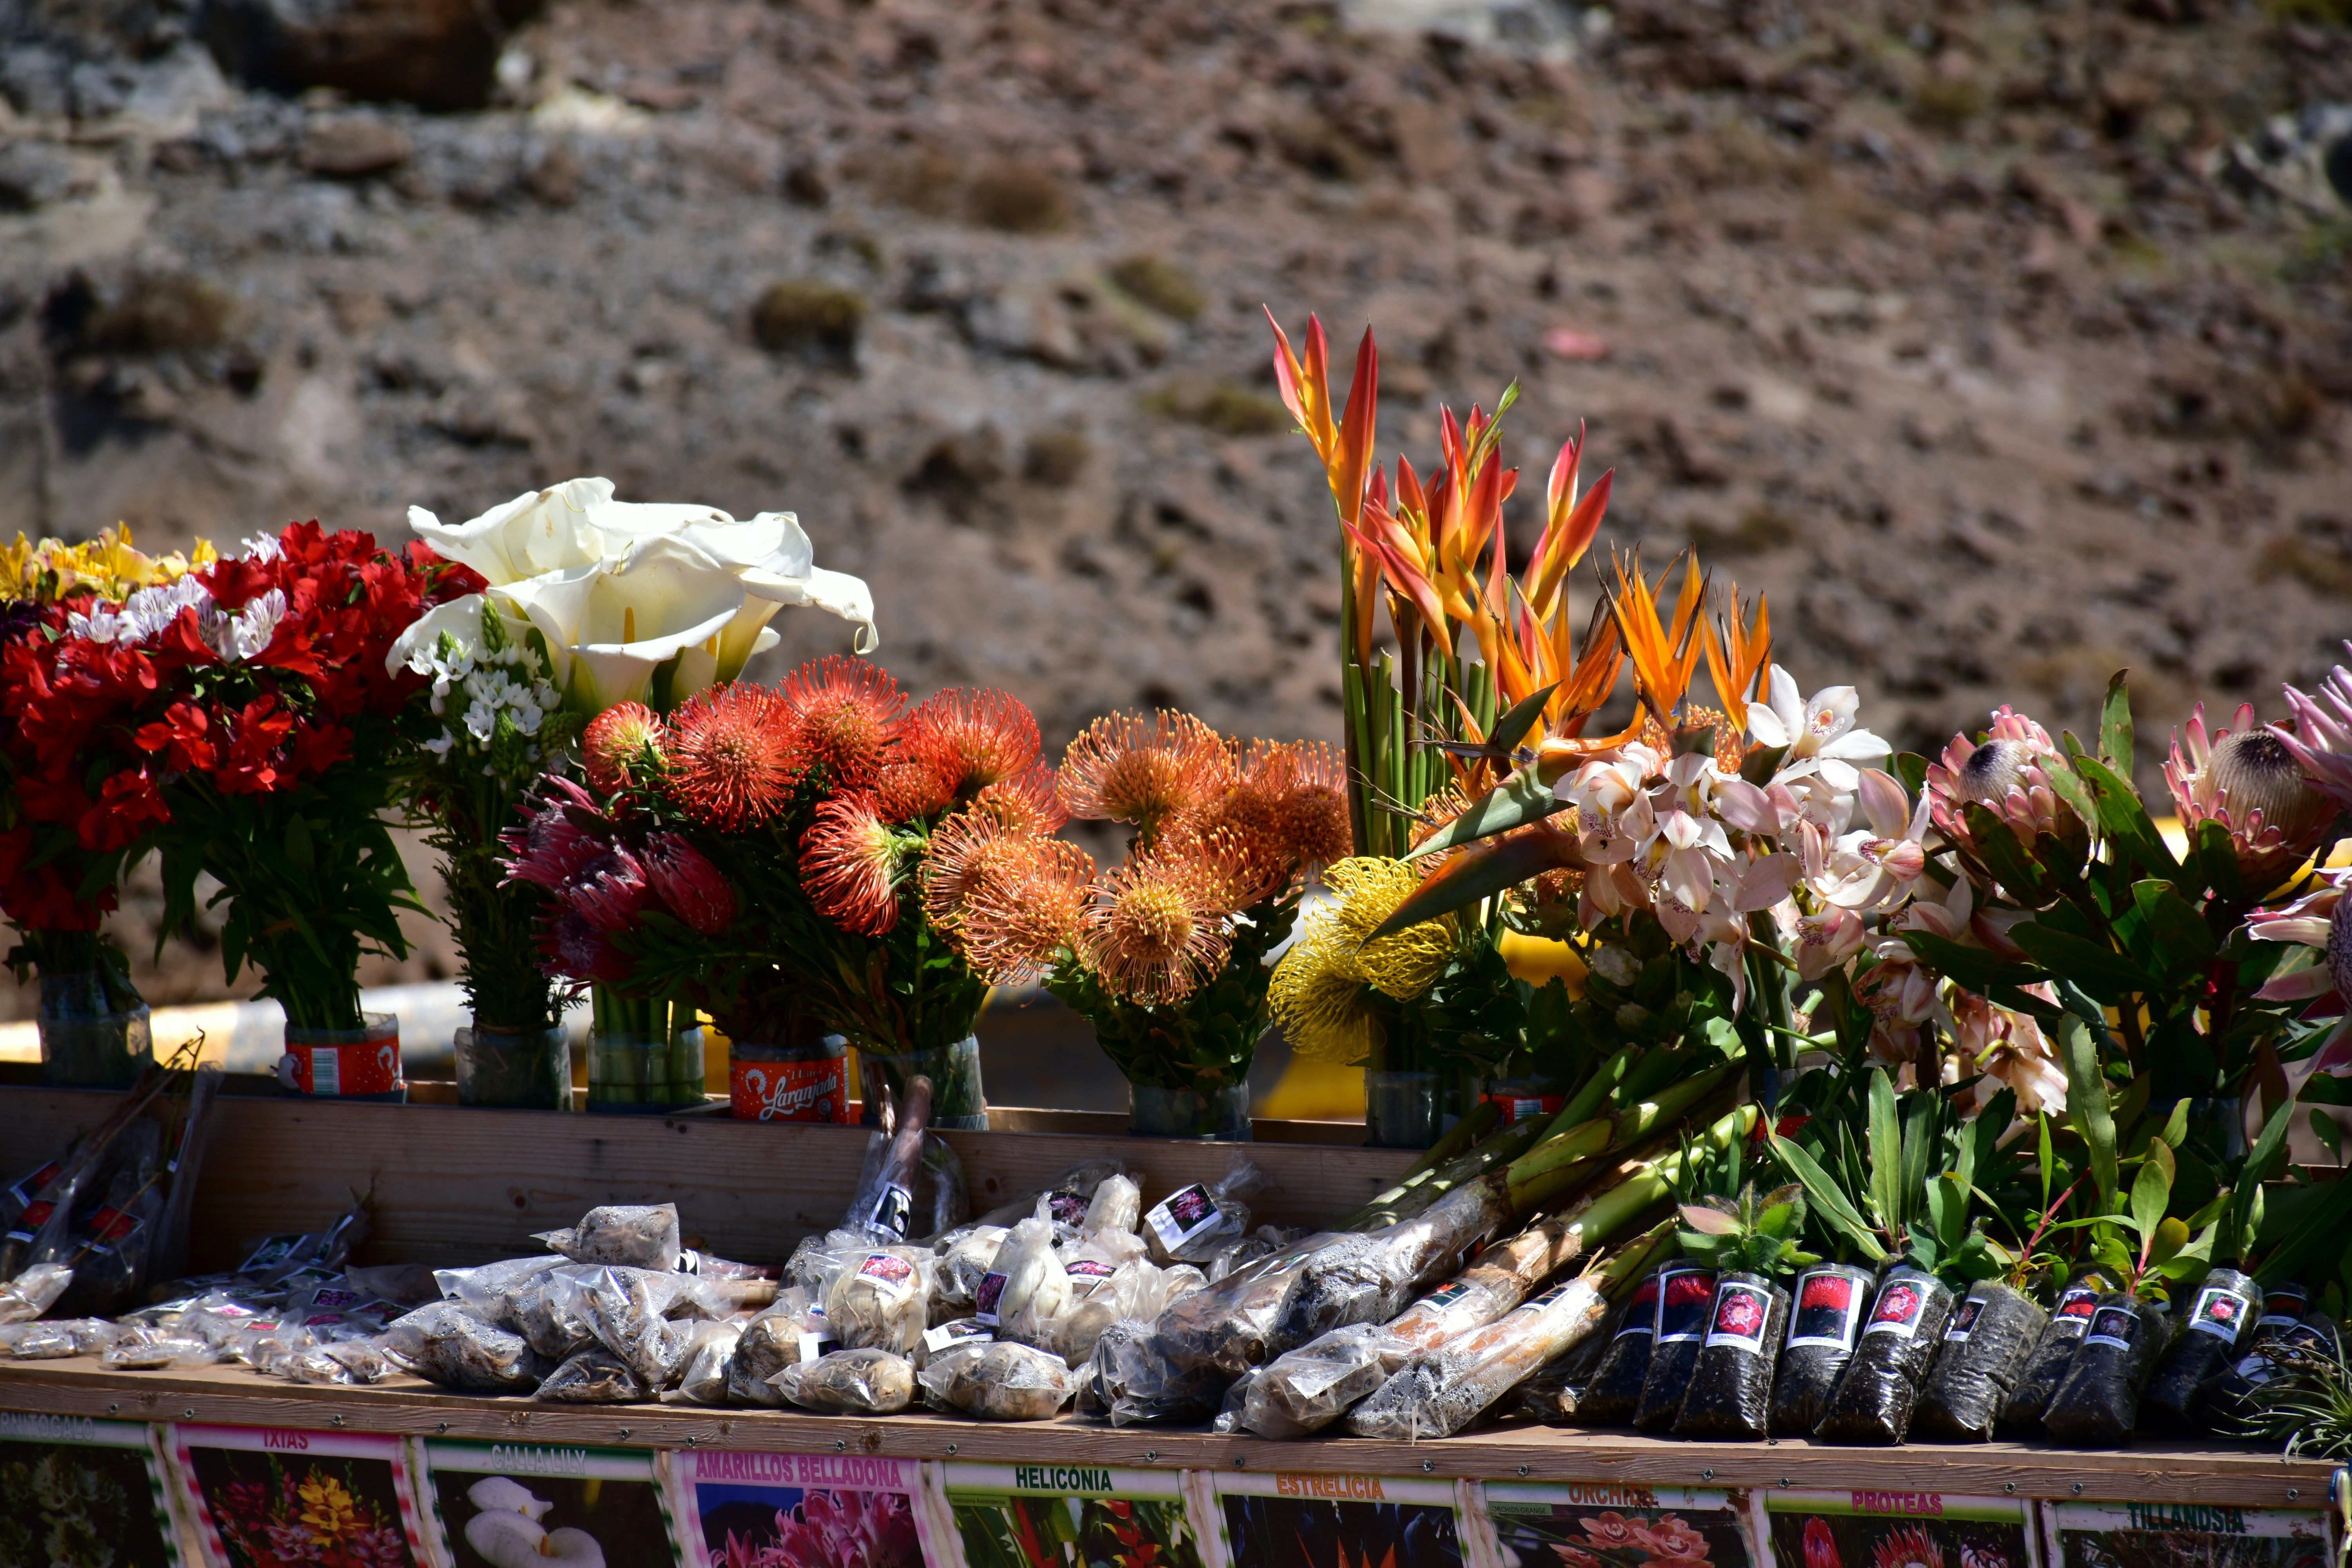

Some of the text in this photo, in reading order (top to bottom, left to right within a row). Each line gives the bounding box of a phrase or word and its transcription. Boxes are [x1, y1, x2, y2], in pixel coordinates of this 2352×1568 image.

[759, 1072, 838, 1121] Laranjada
[264, 1428, 308, 1450] IXIAS
[492, 1444, 586, 1475] CALLA LILY
[696, 1451, 903, 1488] AMARILLOS BELLADONA
[1569, 1482, 1654, 1506] ORCHIDS
[1852, 1491, 1943, 1515] PROTEAS
[2127, 1502, 2247, 1534] TILLANDSIA
